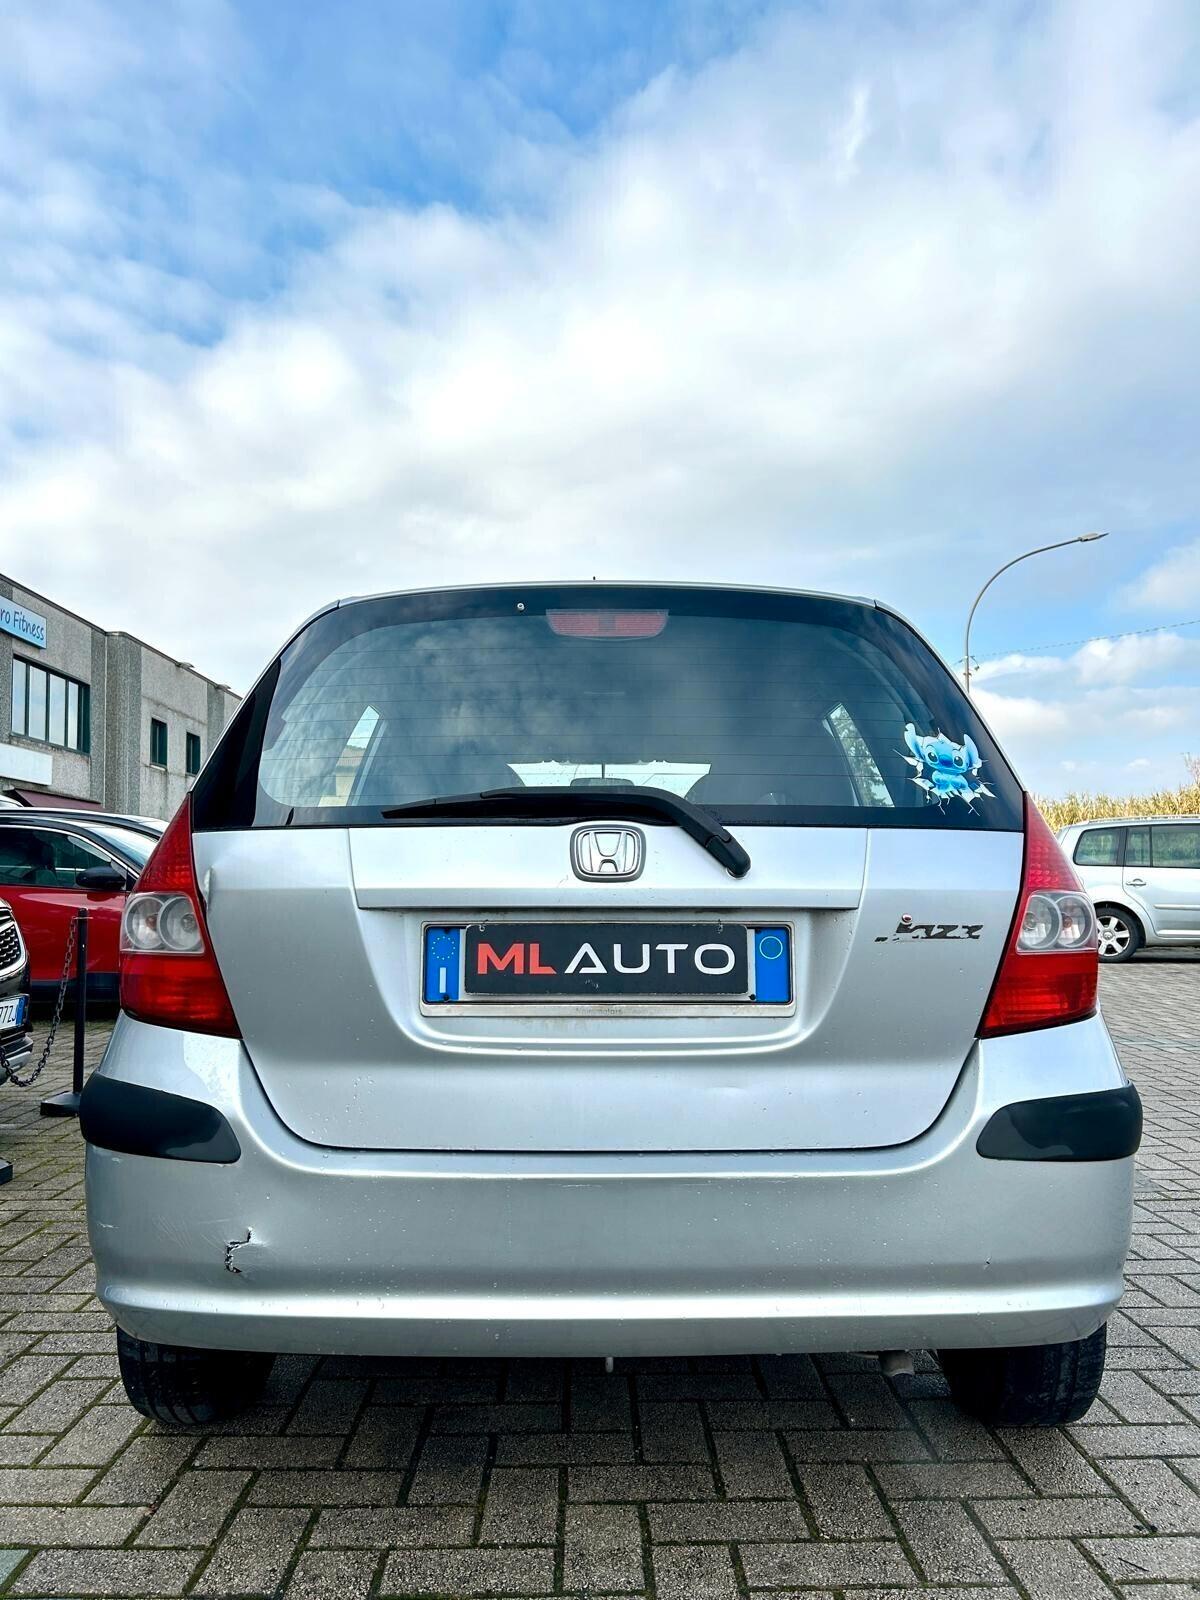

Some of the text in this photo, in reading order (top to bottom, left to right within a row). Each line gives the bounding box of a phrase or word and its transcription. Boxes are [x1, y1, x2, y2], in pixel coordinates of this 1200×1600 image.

[13, 611, 44, 640] Fitness
[477, 943, 736, 975] ML AUTO
